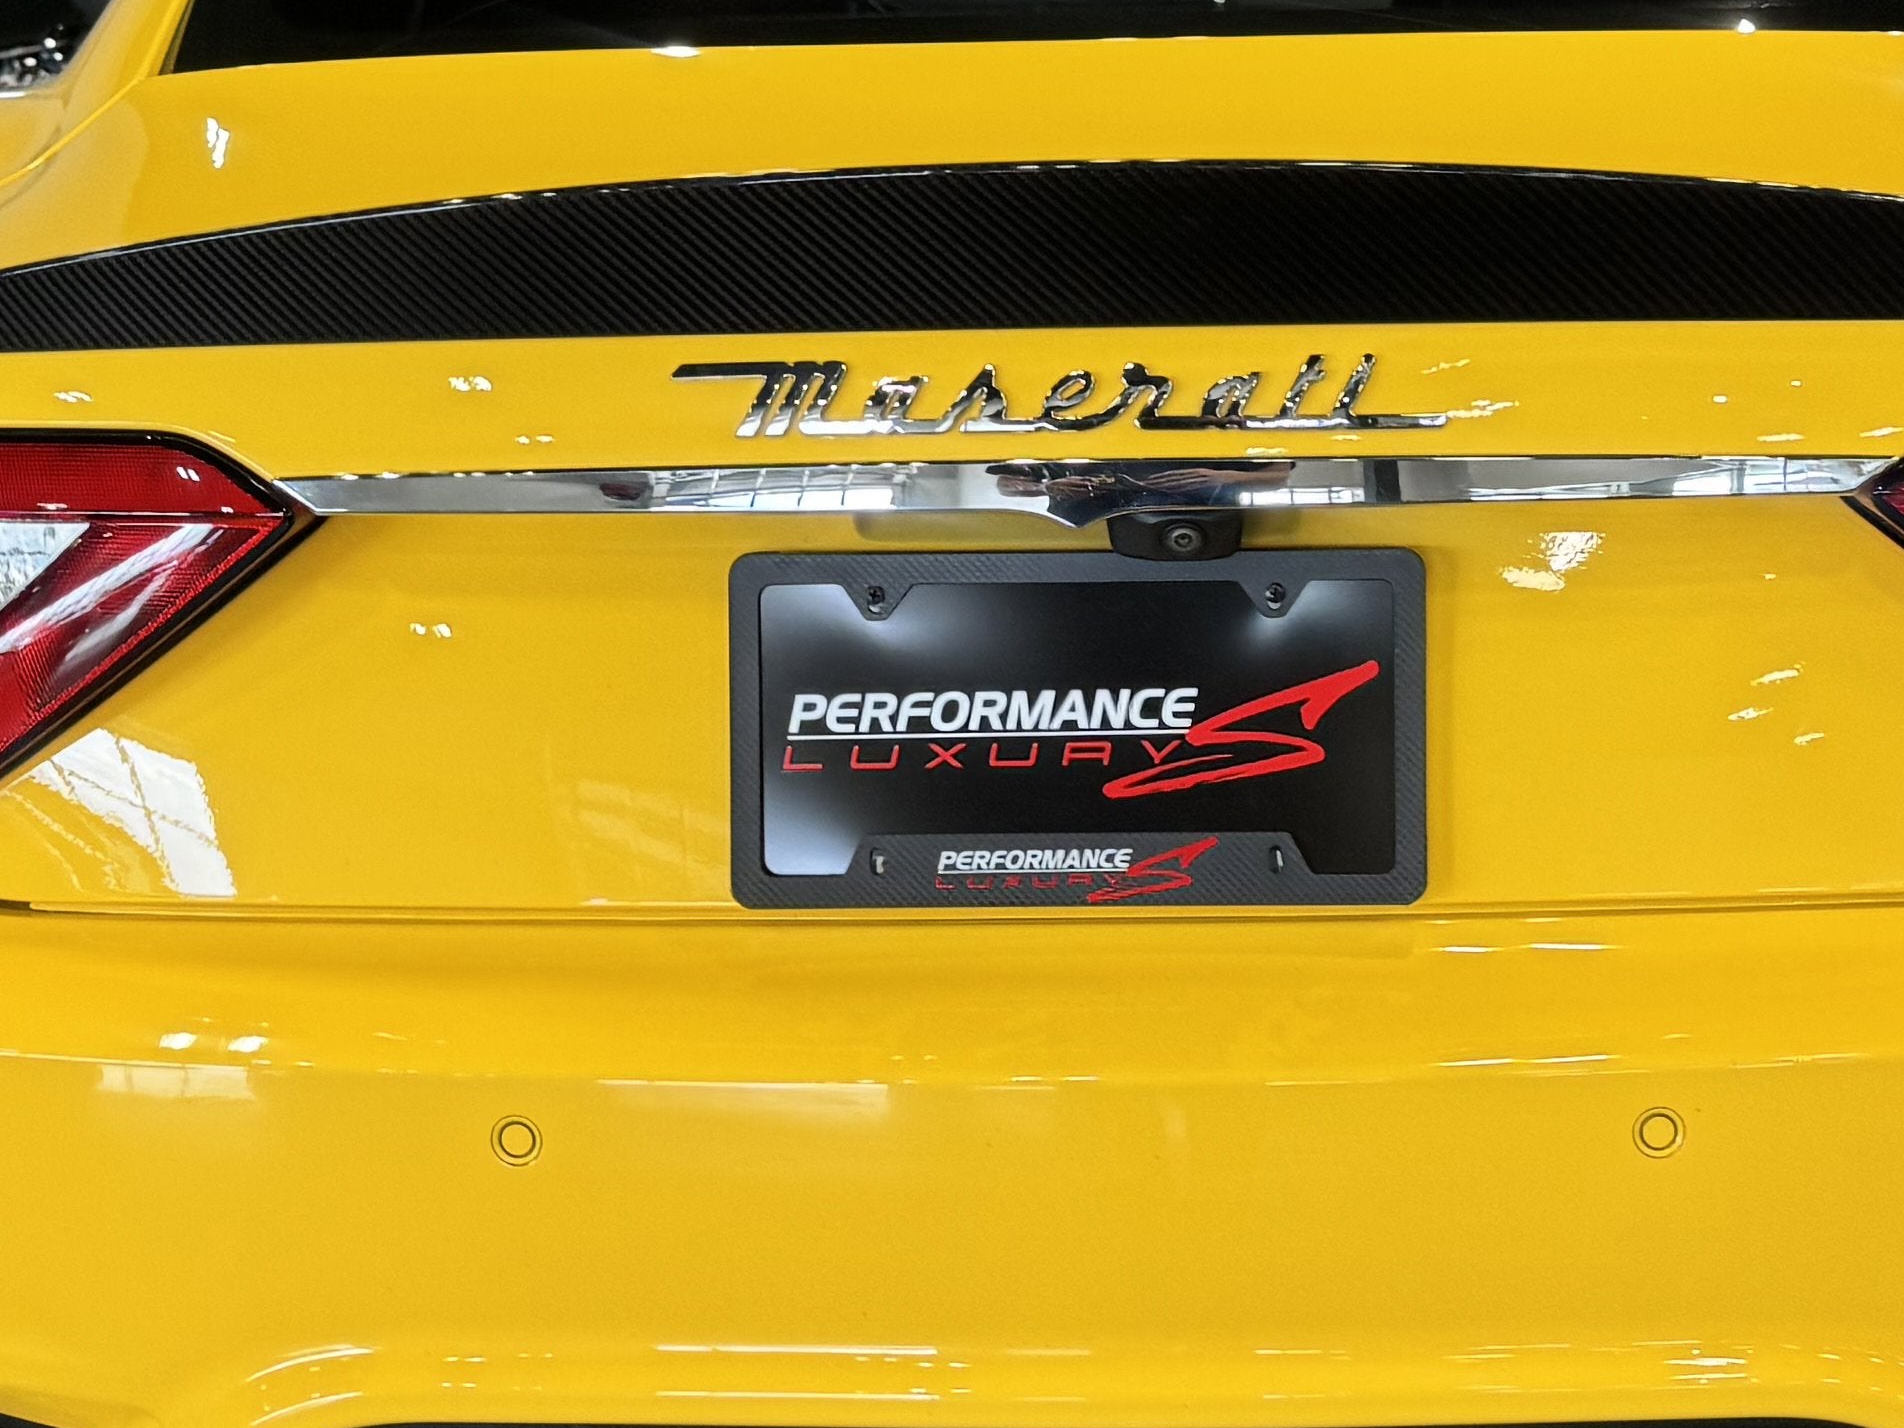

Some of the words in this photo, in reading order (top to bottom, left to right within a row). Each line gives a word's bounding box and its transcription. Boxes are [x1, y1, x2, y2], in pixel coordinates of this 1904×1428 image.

[671, 352, 1448, 439] Maserati
[787, 687, 1199, 734] PERFORMANCE
[782, 739, 1182, 771] LUXURY
[937, 848, 1133, 871] PERFORMANCE
